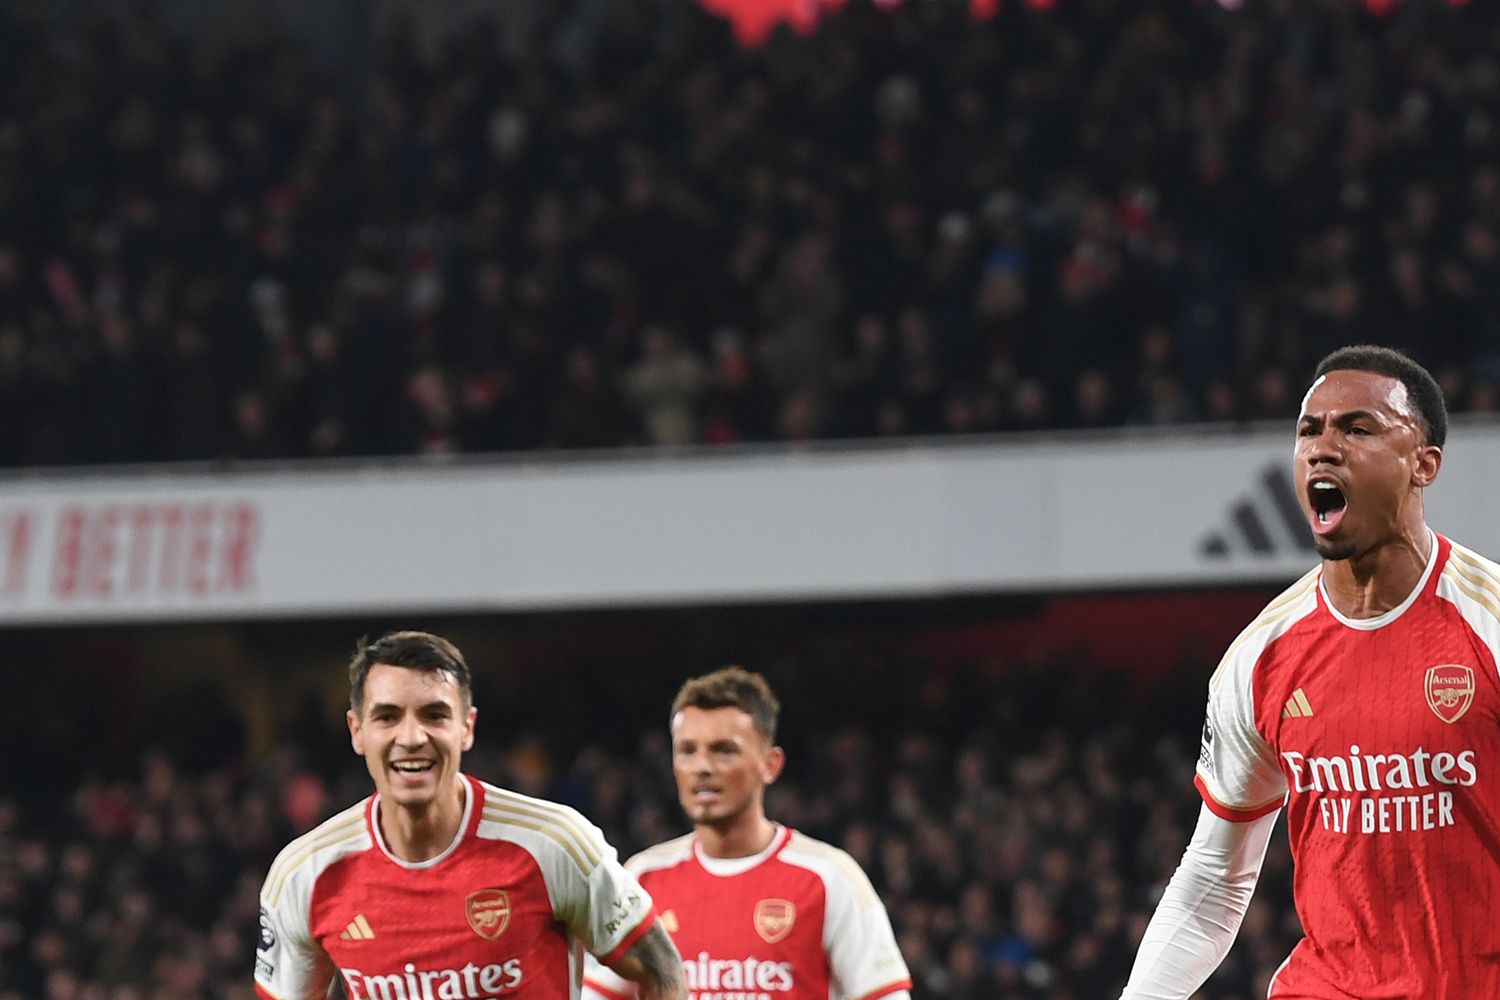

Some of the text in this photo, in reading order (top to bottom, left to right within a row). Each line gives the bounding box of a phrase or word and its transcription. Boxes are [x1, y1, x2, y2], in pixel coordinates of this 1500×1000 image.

[54, 502, 258, 598] BETTER
[1432, 675, 1467, 685] Arsenal
[1281, 744, 1477, 793] Emirates
[1319, 791, 1455, 834] FLY BETTER
[682, 951, 794, 992] irates
